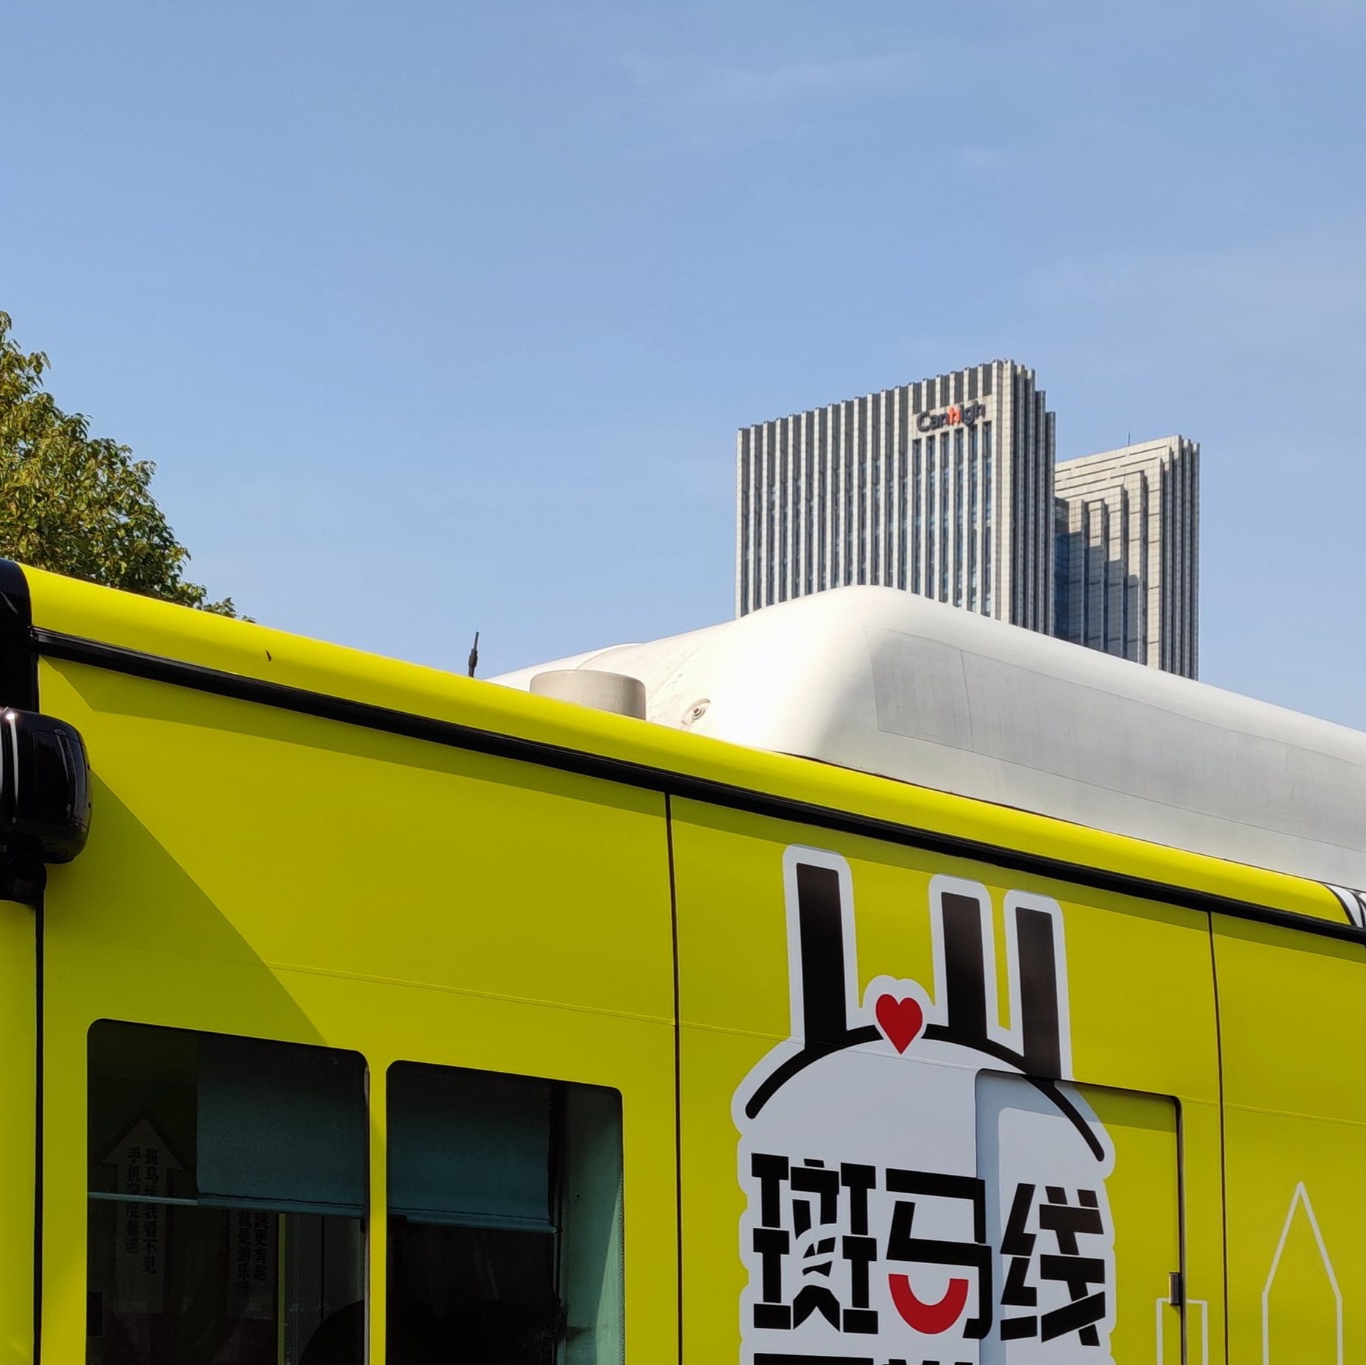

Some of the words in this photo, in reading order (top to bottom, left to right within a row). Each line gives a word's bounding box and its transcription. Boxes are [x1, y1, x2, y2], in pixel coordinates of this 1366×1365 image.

[917, 401, 986, 433] Canhigh
[752, 1152, 1106, 1347] 斑马线
